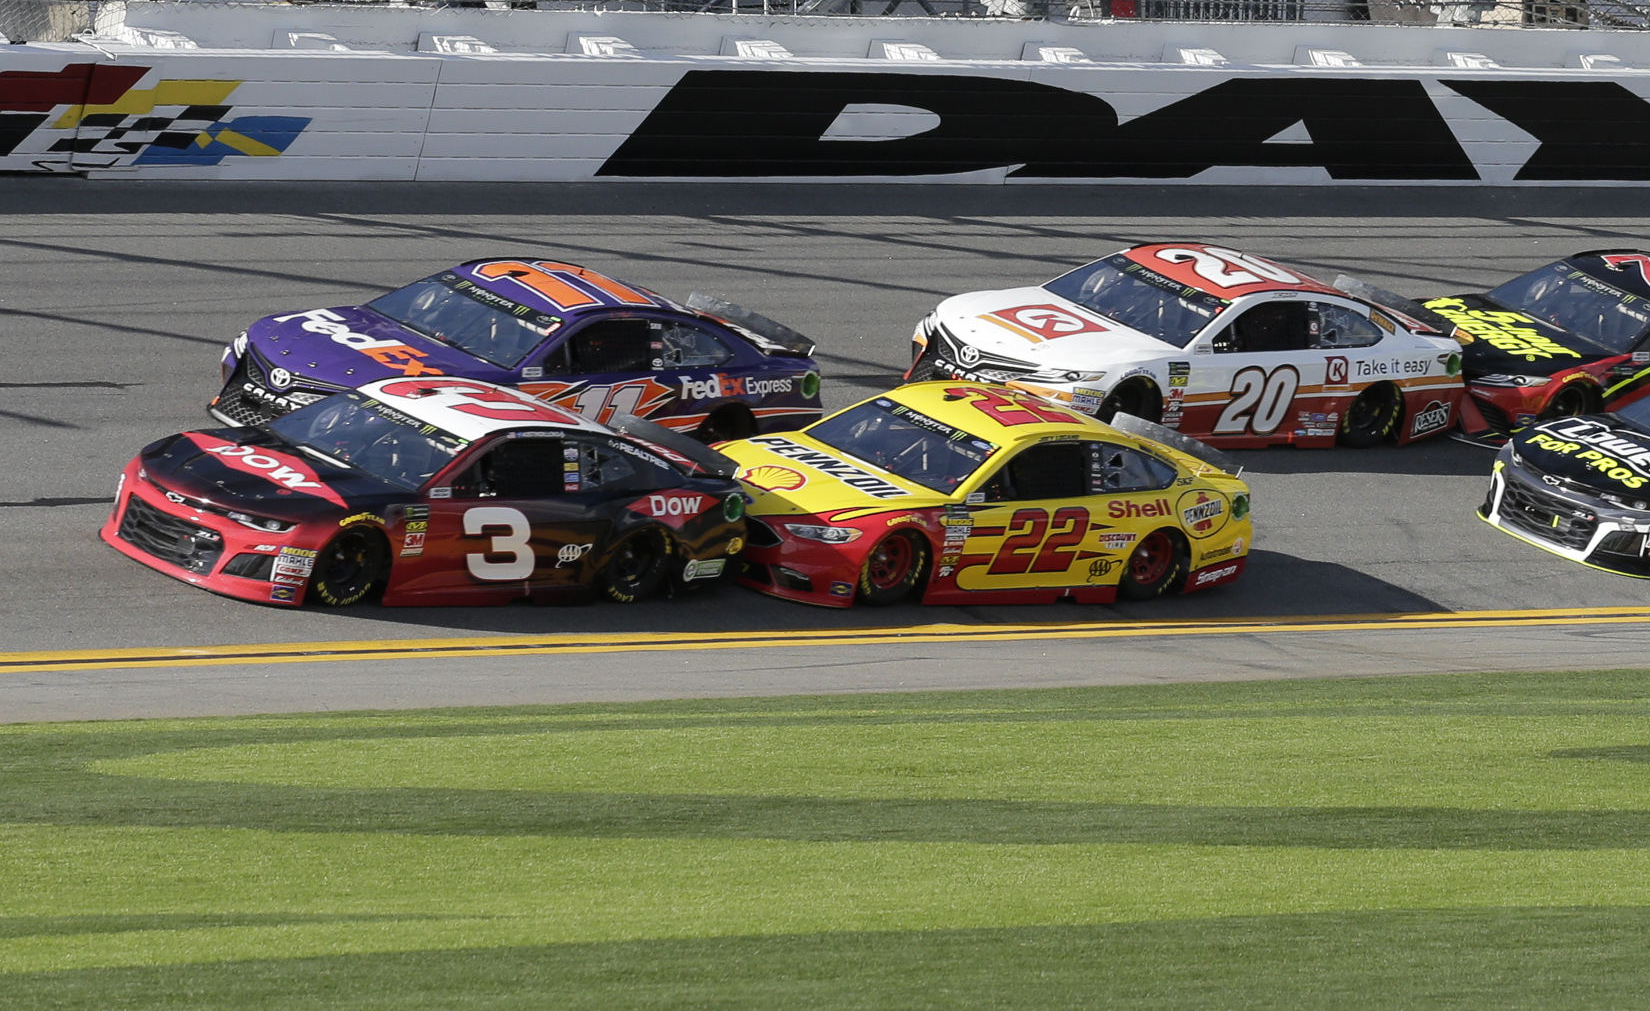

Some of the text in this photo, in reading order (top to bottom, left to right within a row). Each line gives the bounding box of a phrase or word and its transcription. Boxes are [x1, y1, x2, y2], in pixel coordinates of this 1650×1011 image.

[1155, 245, 1303, 289] 20
[471, 260, 662, 313] 11
[272, 308, 445, 376] FedEx
[933, 358, 992, 383] CAMRY
[1356, 359, 1432, 376] Take it easy
[243, 383, 302, 411] CAMRY
[678, 372, 793, 401] FedEx Express
[1072, 395, 1101, 405] MAHLE
[1074, 388, 1104, 398] MOOG
[1169, 389, 1185, 400] 3M
[1212, 363, 1300, 436] 20
[380, 379, 580, 425] 3
[575, 383, 647, 426] 11
[944, 386, 1084, 427] 22
[748, 435, 913, 500] PENNZOIL
[1525, 433, 1650, 489] FOR PROS
[338, 511, 386, 527] GOODYEAR
[1108, 498, 1172, 519] Shell
[1183, 498, 1223, 525] PENNZOIL
[404, 533, 426, 547] 3M
[462, 506, 536, 581] 3
[986, 505, 1092, 576] 22
[1098, 532, 1137, 543] DISCOUNT
[278, 555, 314, 567] MAHLE
[281, 545, 318, 558] MOOG
[1195, 564, 1238, 586] Snap-on
